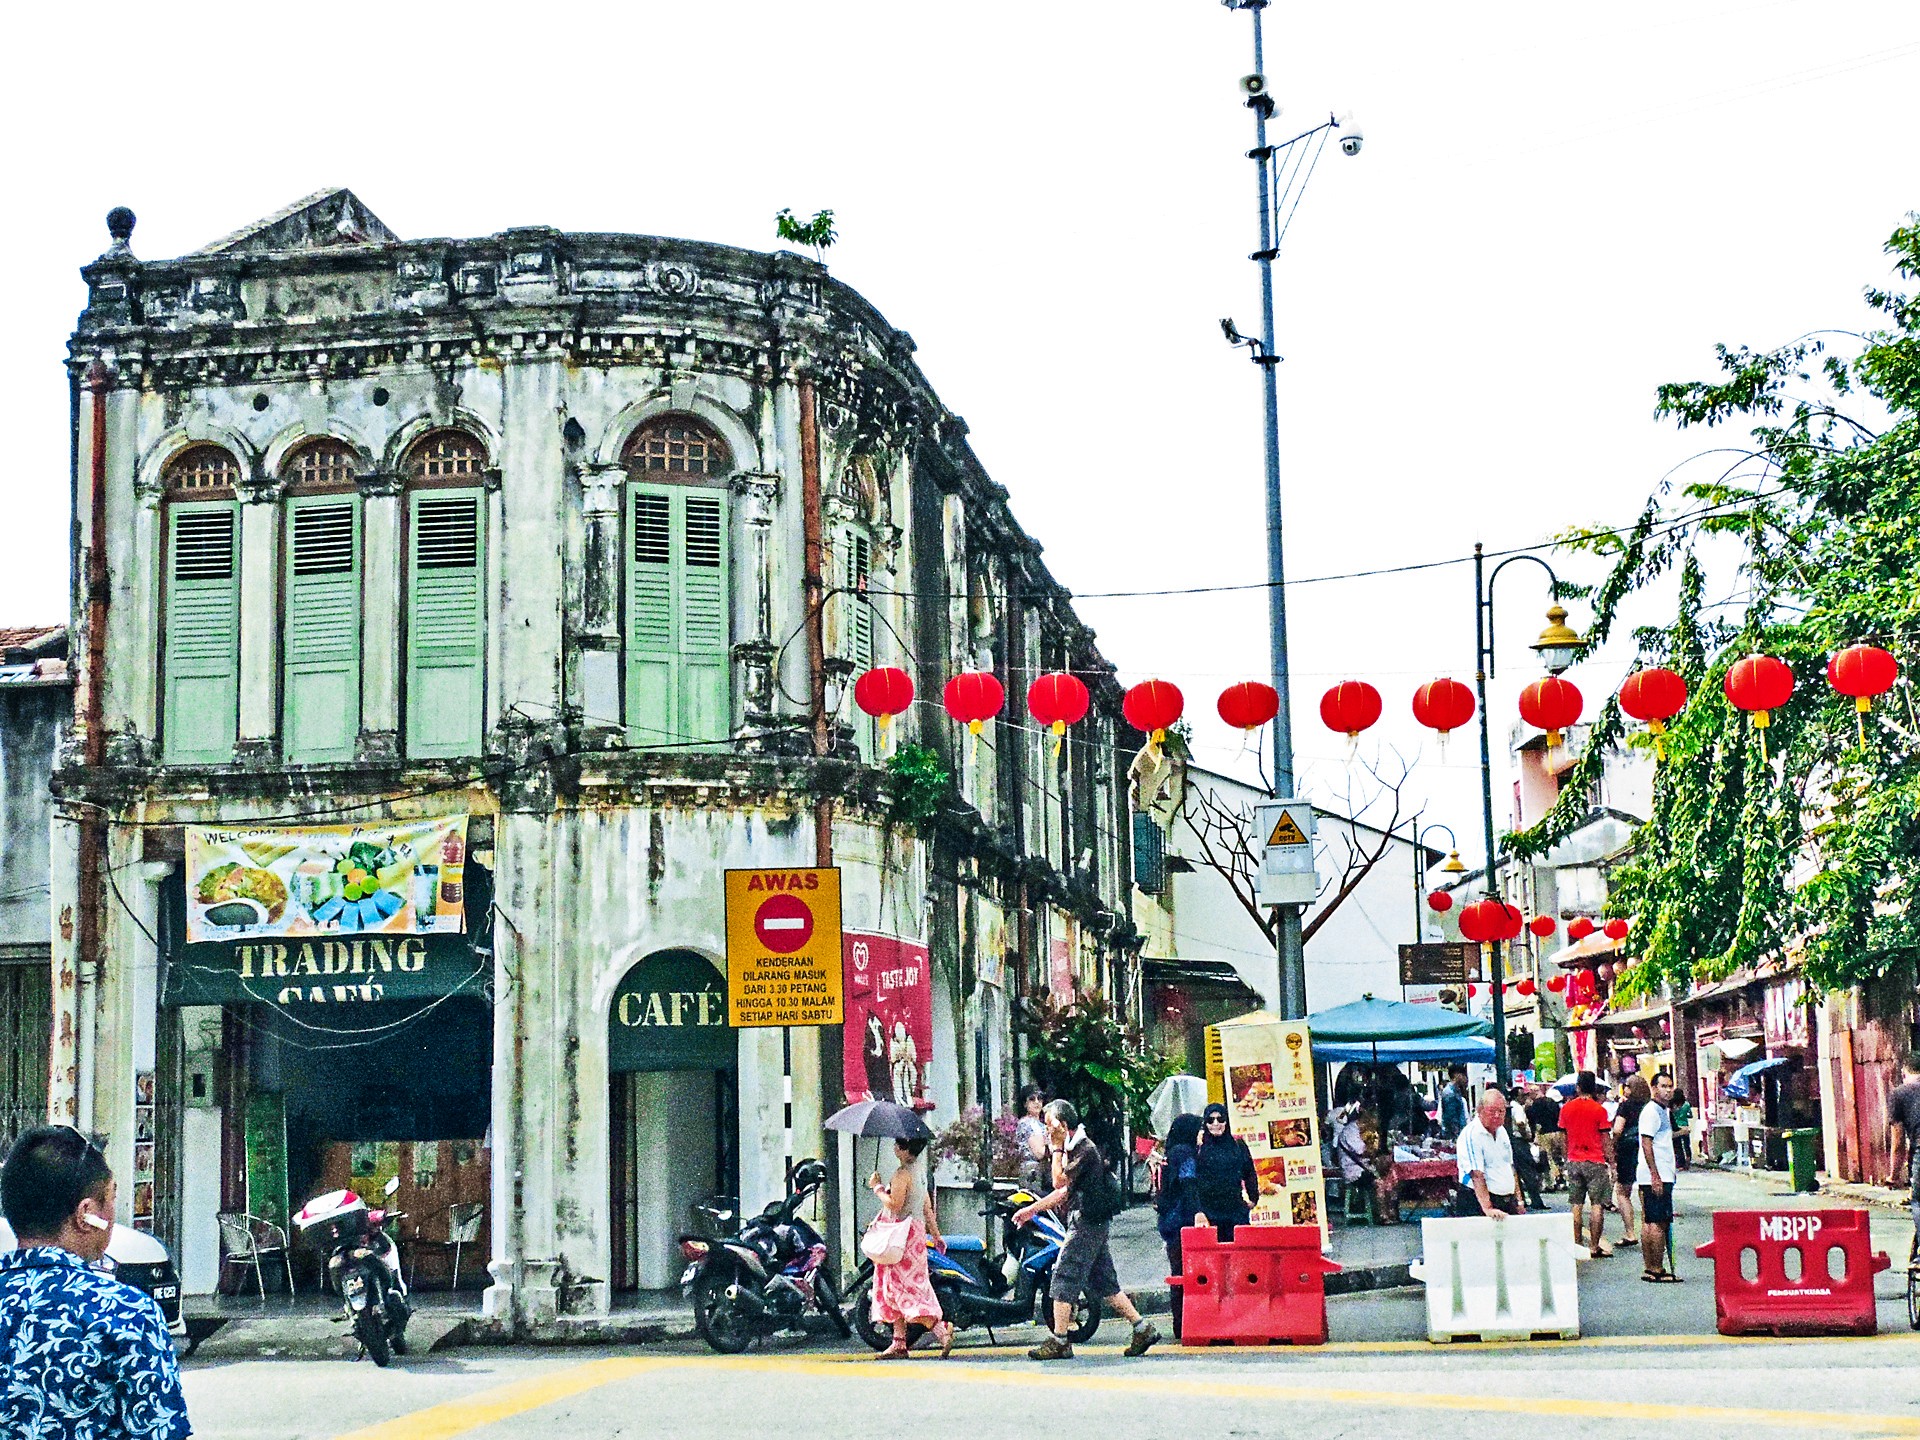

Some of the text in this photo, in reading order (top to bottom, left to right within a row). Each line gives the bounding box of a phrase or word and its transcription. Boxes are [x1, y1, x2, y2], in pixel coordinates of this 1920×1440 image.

[747, 872, 820, 891] AWAS
[235, 938, 428, 978] TRADING
[756, 957, 814, 968] KENDERAAN
[743, 970, 827, 982] DILARANG MASUK
[881, 966, 919, 989] TASTE JOY
[743, 983, 827, 995] DARI 3.30 PETANG
[618, 982, 723, 1027] CAFÉ
[736, 995, 836, 1009] HINGGA 10.30 MALAM
[740, 1009, 833, 1022] SETIAP HARI SABTU
[1759, 1216, 1822, 1241] MBPP
[1767, 1287, 1832, 1297] PENGUATKUASA
